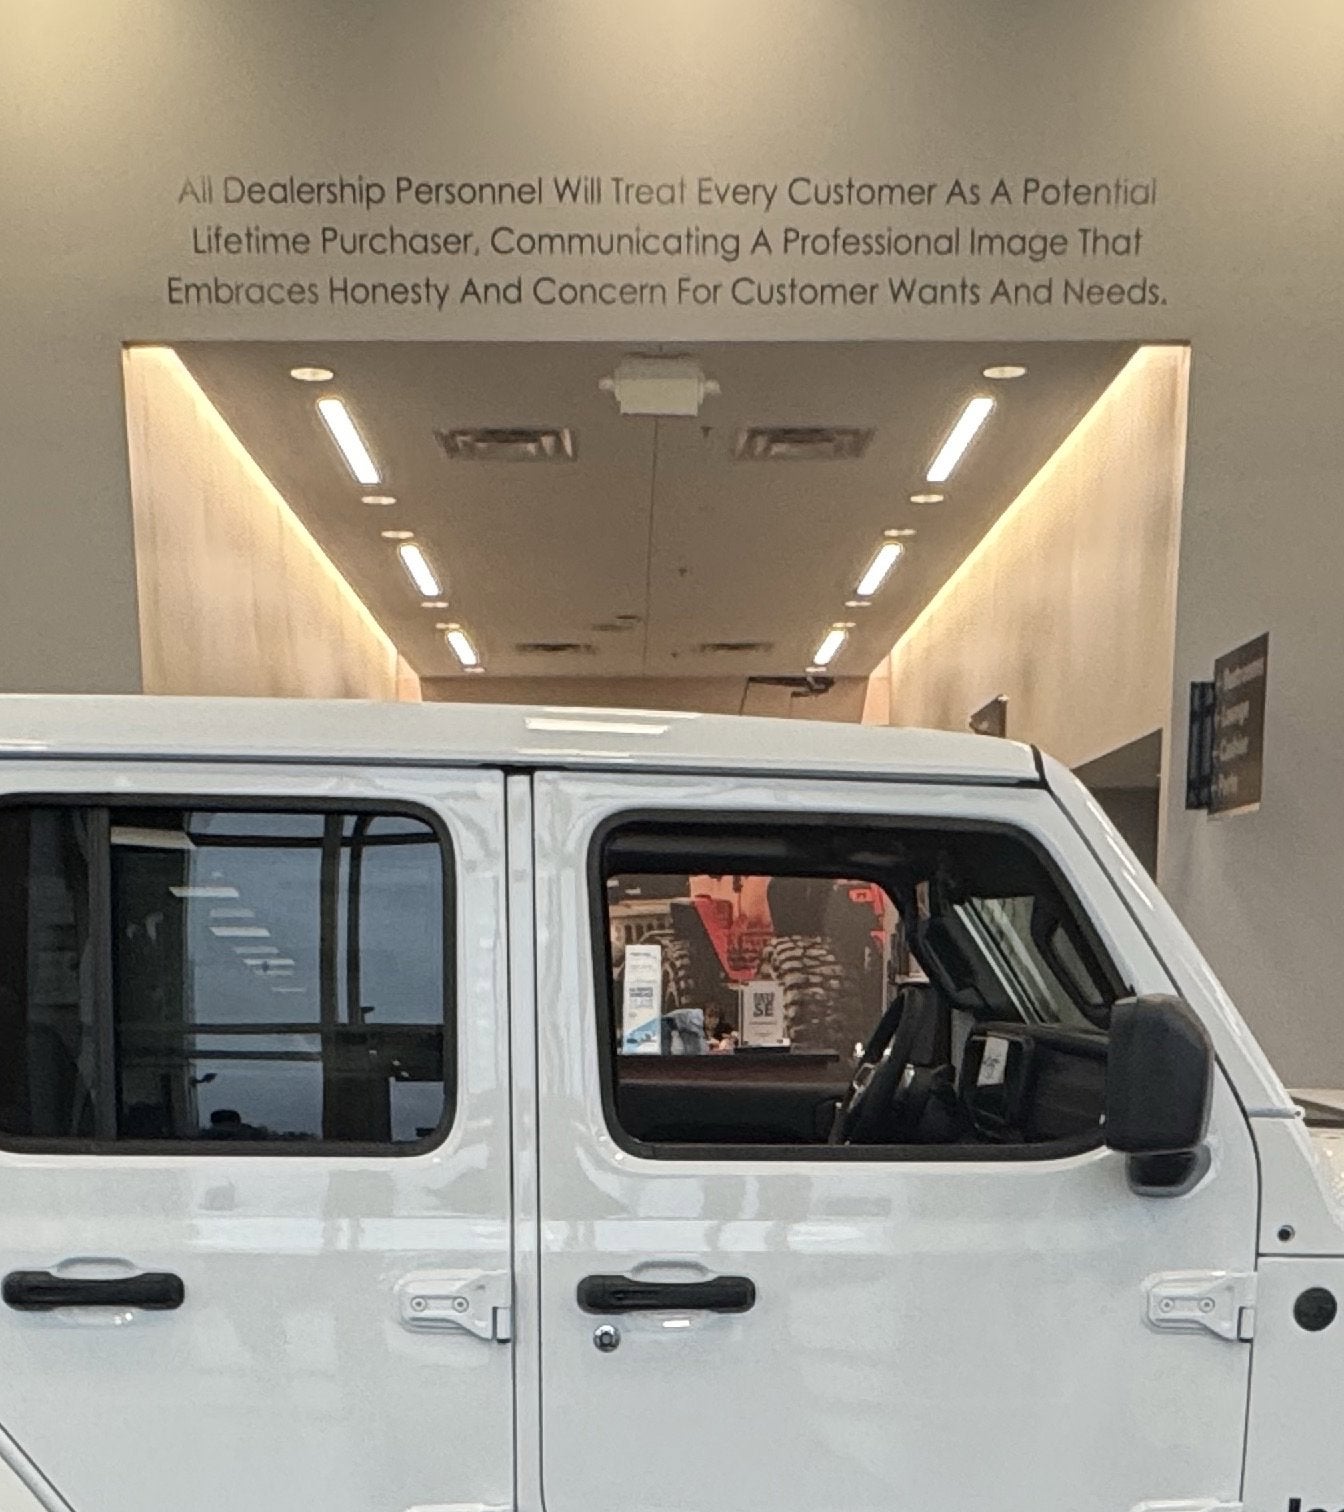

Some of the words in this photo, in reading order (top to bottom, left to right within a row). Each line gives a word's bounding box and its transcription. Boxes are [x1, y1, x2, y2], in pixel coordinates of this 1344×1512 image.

[177, 176, 214, 204] All
[223, 174, 387, 211] Dealership
[395, 175, 543, 206] Personnel
[552, 175, 602, 205] Will
[610, 176, 687, 206] Treat
[697, 176, 779, 213] Every
[787, 175, 938, 207] Customer
[945, 177, 982, 206] As
[989, 177, 1013, 206] A
[1022, 176, 1158, 207] Potential
[192, 224, 311, 256] Lifetime
[320, 224, 480, 257] Purchaser,
[490, 225, 741, 264] Communicating
[749, 227, 773, 256] A
[782, 225, 961, 257] Professional
[969, 227, 1069, 263] Image
[1077, 227, 1143, 257] That
[166, 275, 320, 306] Embraces
[328, 276, 450, 312] Honesty
[459, 275, 523, 305] And
[532, 275, 667, 306] Concern
[677, 276, 723, 306] For
[730, 276, 880, 306] Customer
[888, 276, 981, 306] Wants
[989, 277, 1053, 306] And
[1063, 276, 1168, 306] Needs.
